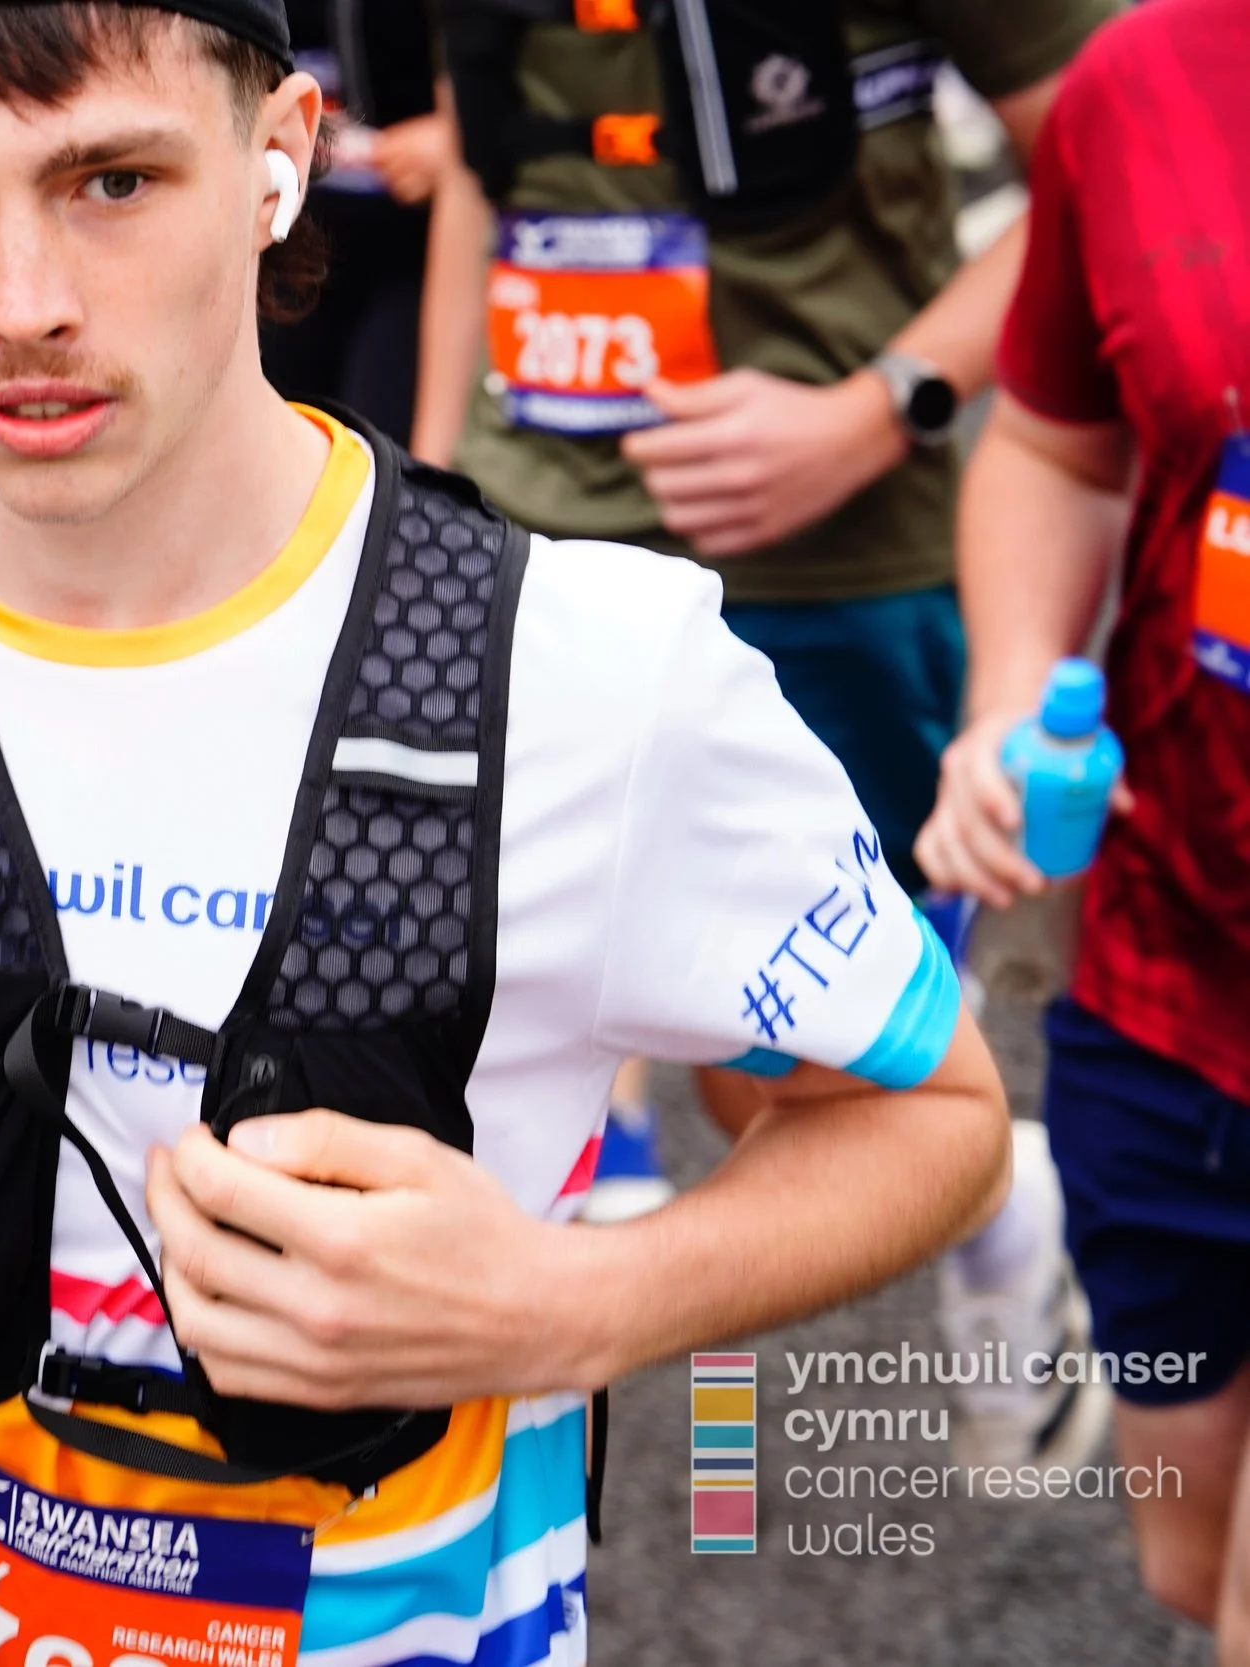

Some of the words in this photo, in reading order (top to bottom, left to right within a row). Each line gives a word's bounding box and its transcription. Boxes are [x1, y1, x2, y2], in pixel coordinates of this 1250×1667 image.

[515, 312, 659, 388] 2073
[20, 1491, 199, 1559] SWANSEA
[112, 1625, 214, 1666] RESEARCH
[217, 1644, 283, 1667] WALES
[207, 1620, 285, 1649] CANCER
